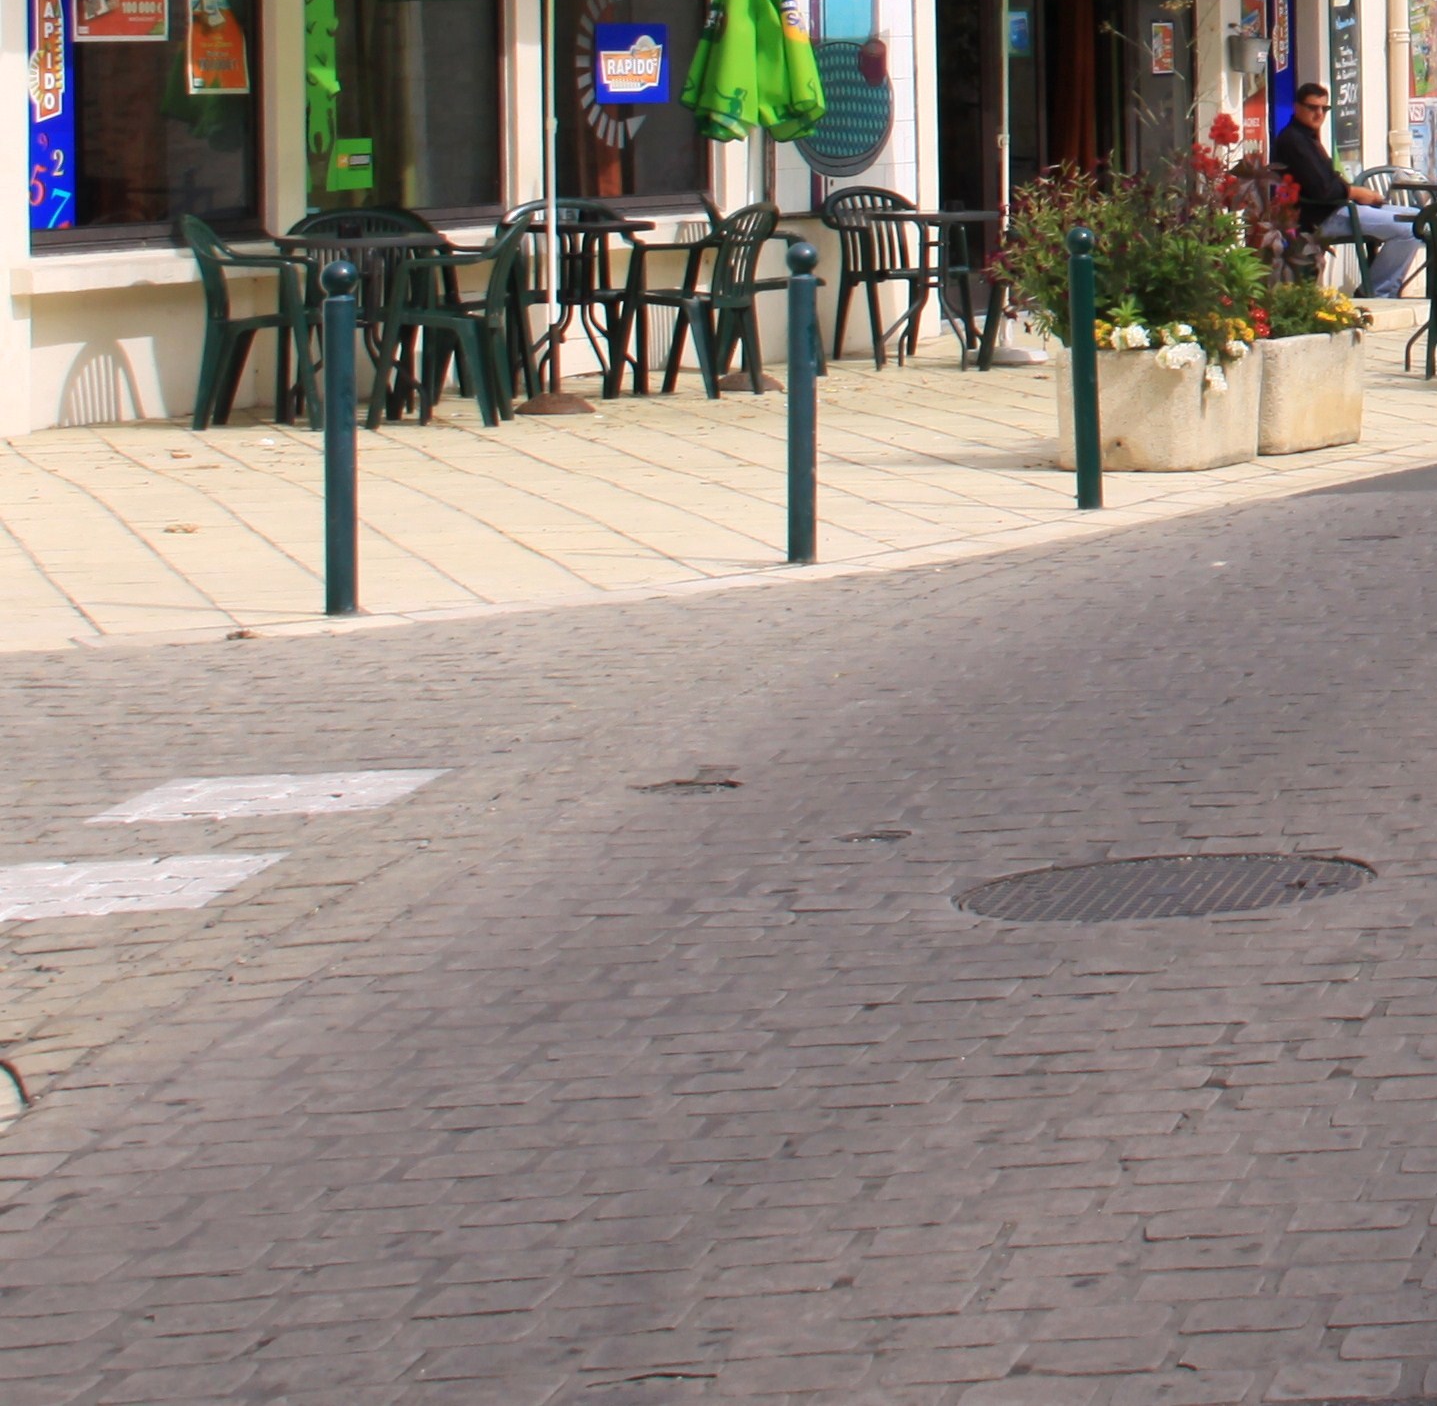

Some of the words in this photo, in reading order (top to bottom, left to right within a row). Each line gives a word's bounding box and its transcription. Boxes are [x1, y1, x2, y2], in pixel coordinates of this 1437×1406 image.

[607, 58, 653, 75] RAPIDO
[53, 149, 65, 176] 2
[29, 165, 47, 207] 5
[47, 188, 71, 229] 7
